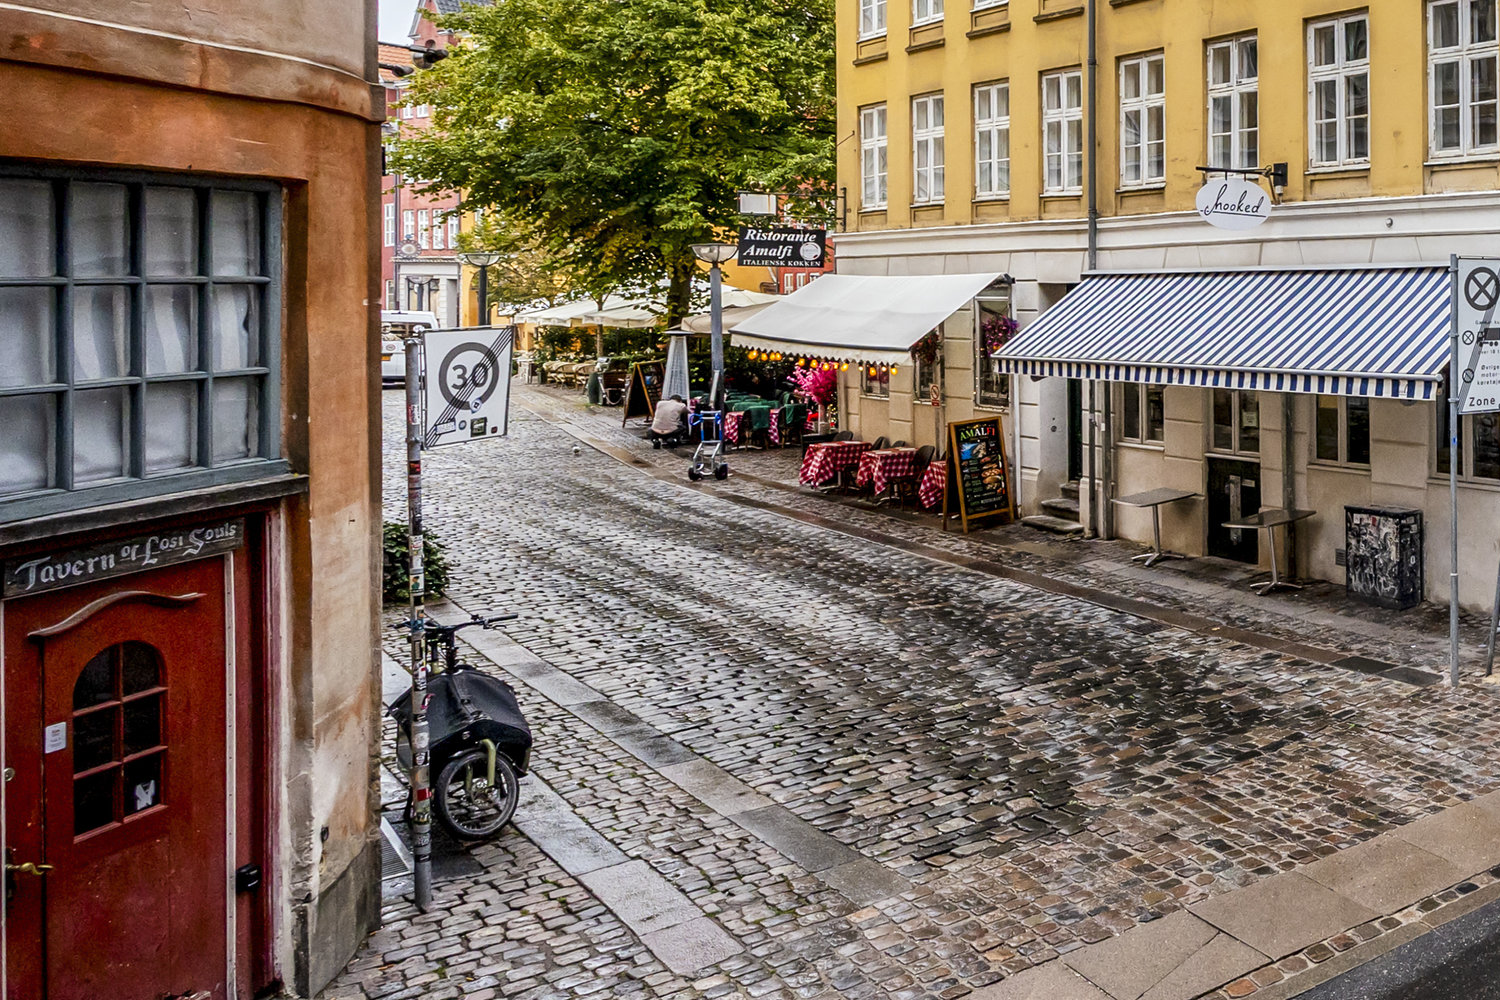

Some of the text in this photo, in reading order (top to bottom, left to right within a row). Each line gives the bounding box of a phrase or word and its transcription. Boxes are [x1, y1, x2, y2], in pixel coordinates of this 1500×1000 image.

[1204, 183, 1265, 216] hooked
[744, 228, 817, 242] Ristorante
[743, 244, 793, 260] Amalfi
[787, 259, 821, 267] KØKKEN
[451, 363, 489, 391] 30
[1469, 396, 1496, 407] Zone
[960, 426, 996, 441] AMALFI
[14, 555, 116, 591] Tavern
[120, 544, 140, 561] of
[182, 521, 237, 557] Souls
